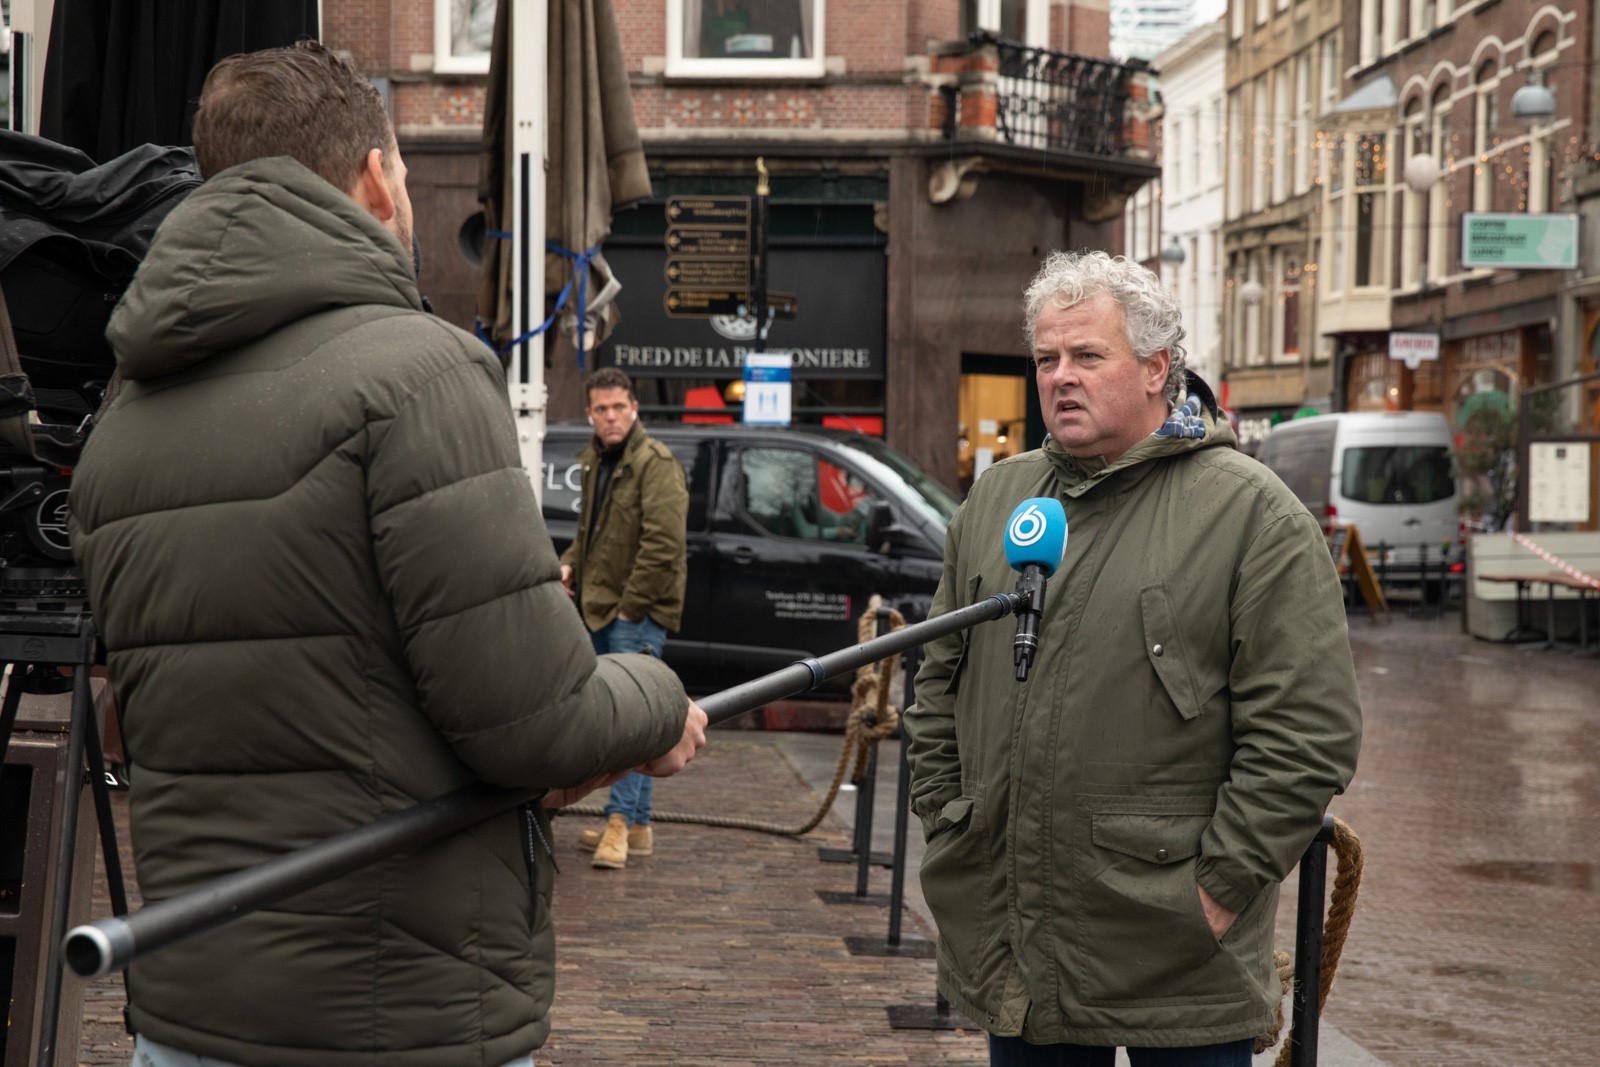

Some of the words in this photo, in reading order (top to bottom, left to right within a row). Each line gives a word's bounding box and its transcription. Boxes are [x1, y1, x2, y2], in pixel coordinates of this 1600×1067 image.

[614, 344, 671, 366] FRED
[674, 346, 703, 367] DE
[706, 347, 730, 367] LA
[733, 345, 870, 368] BONIERE
[1009, 504, 1047, 547] 6
